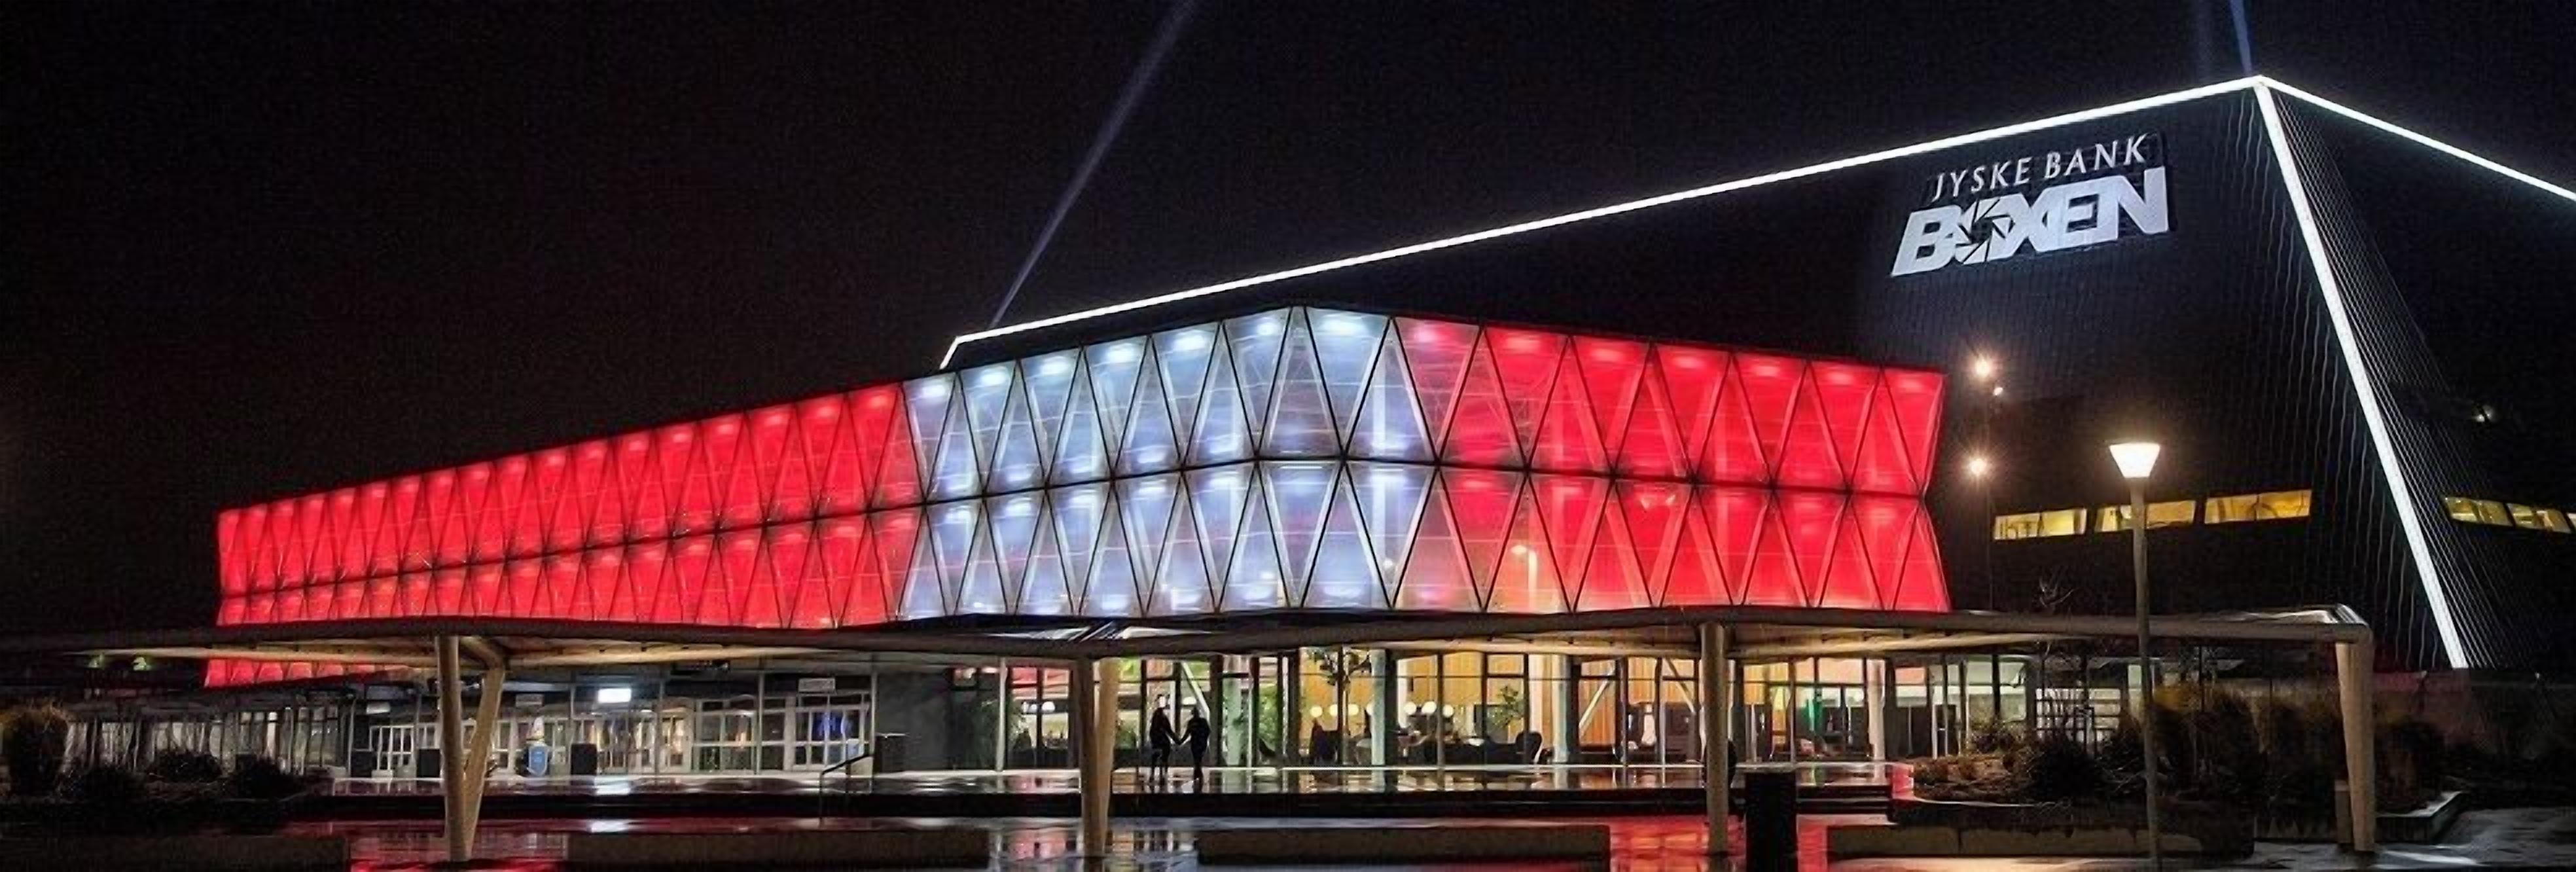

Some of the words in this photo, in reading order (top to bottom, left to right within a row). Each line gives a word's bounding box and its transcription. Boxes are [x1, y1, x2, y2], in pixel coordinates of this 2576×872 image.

[1931, 156, 2033, 202] JYSKE
[2043, 133, 2150, 179] BANK
[1891, 166, 2170, 277] BOXEN
